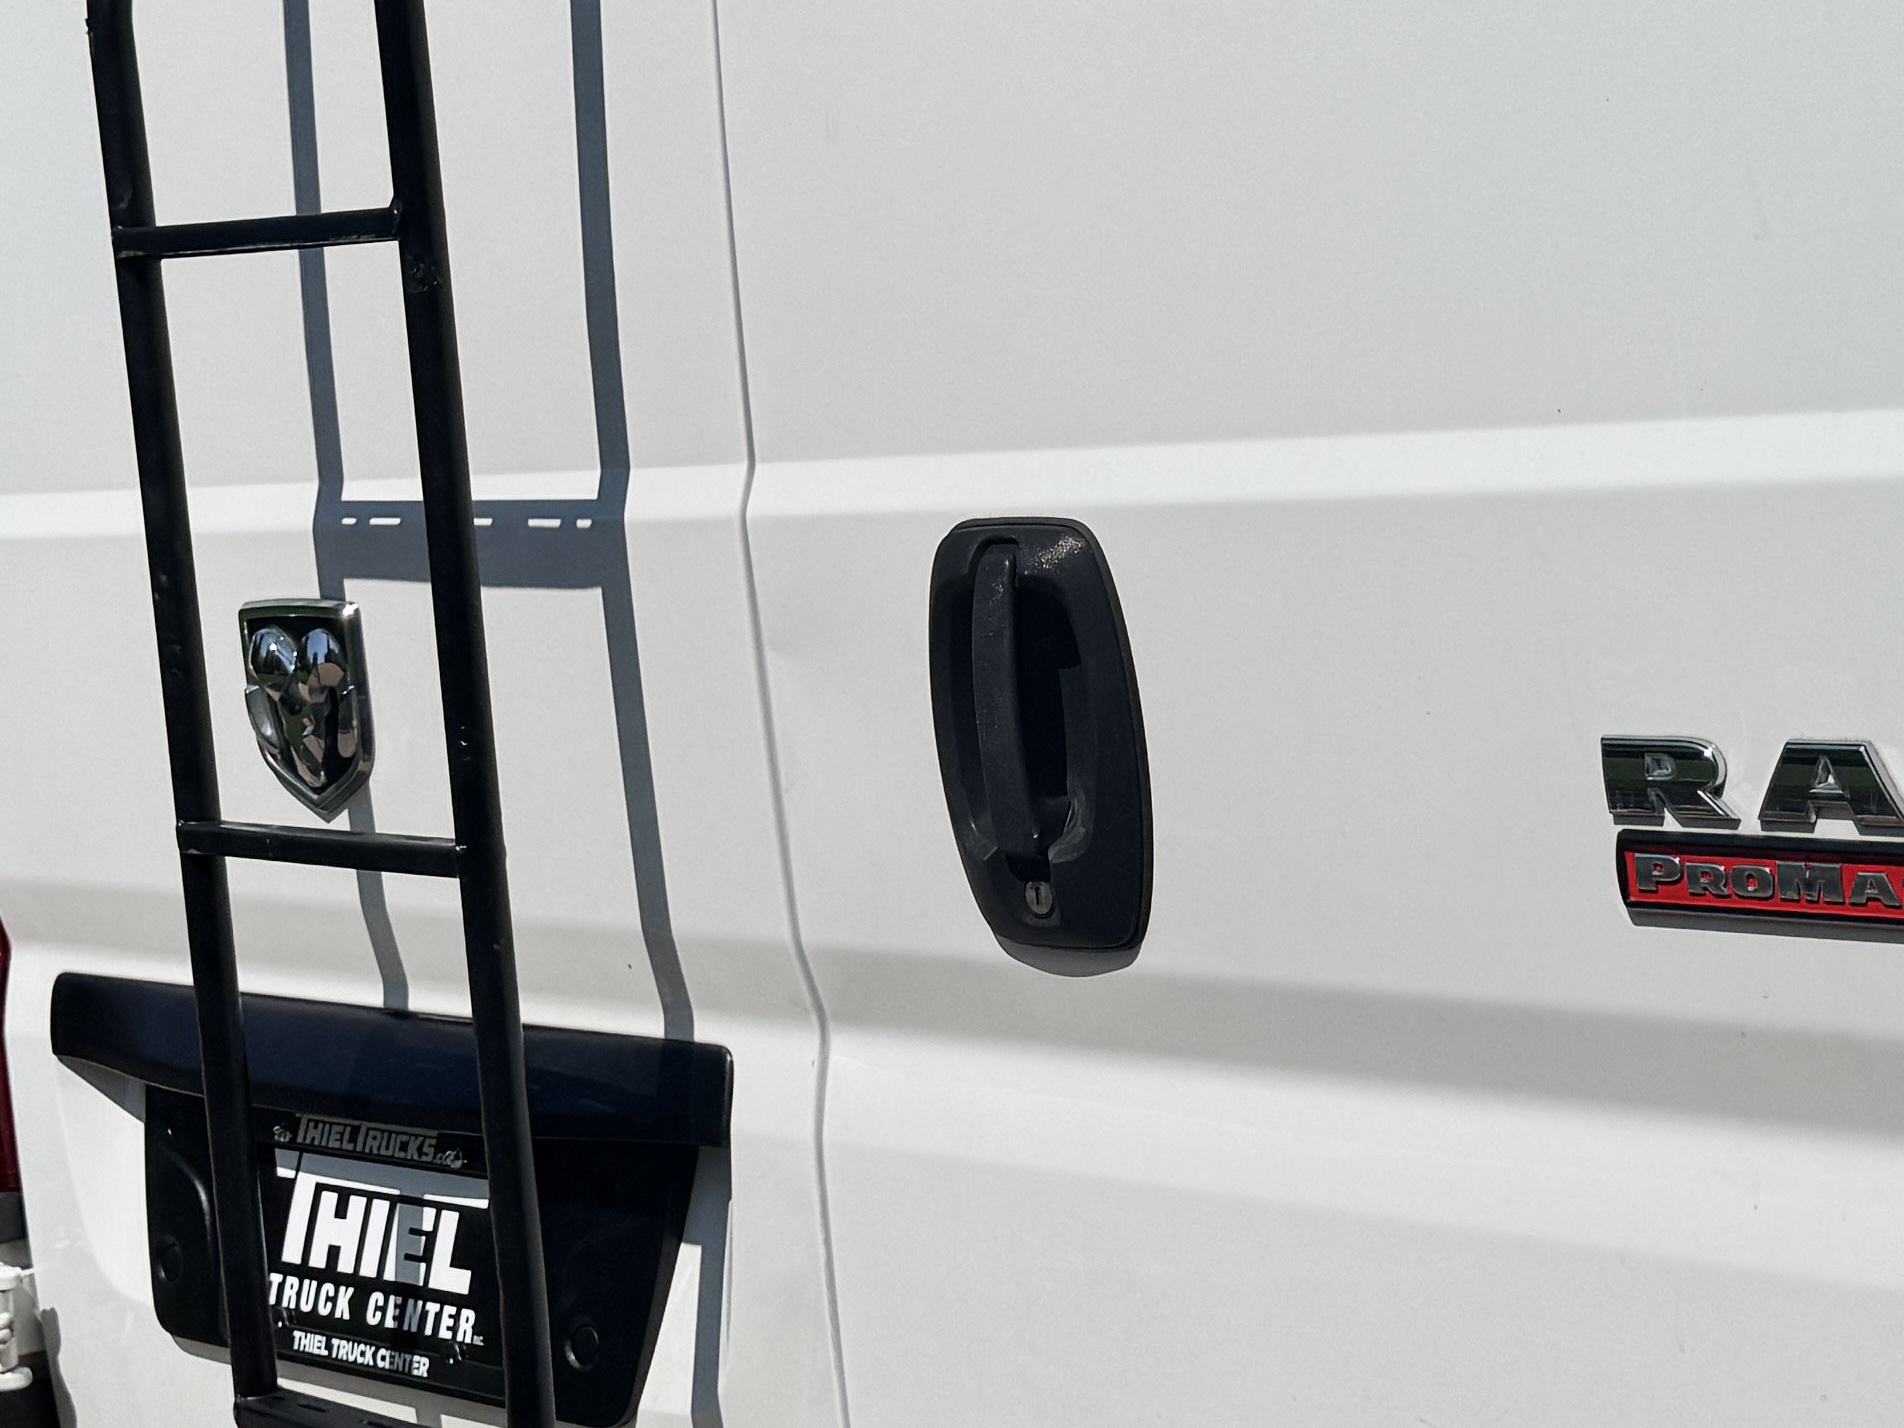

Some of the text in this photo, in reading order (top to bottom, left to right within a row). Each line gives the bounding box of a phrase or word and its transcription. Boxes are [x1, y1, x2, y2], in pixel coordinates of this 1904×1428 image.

[276, 1149, 490, 1295] THIEL
[269, 1272, 477, 1344] TRUCK CENTER
[293, 1329, 431, 1378] THIEL TRUCK CENTER
